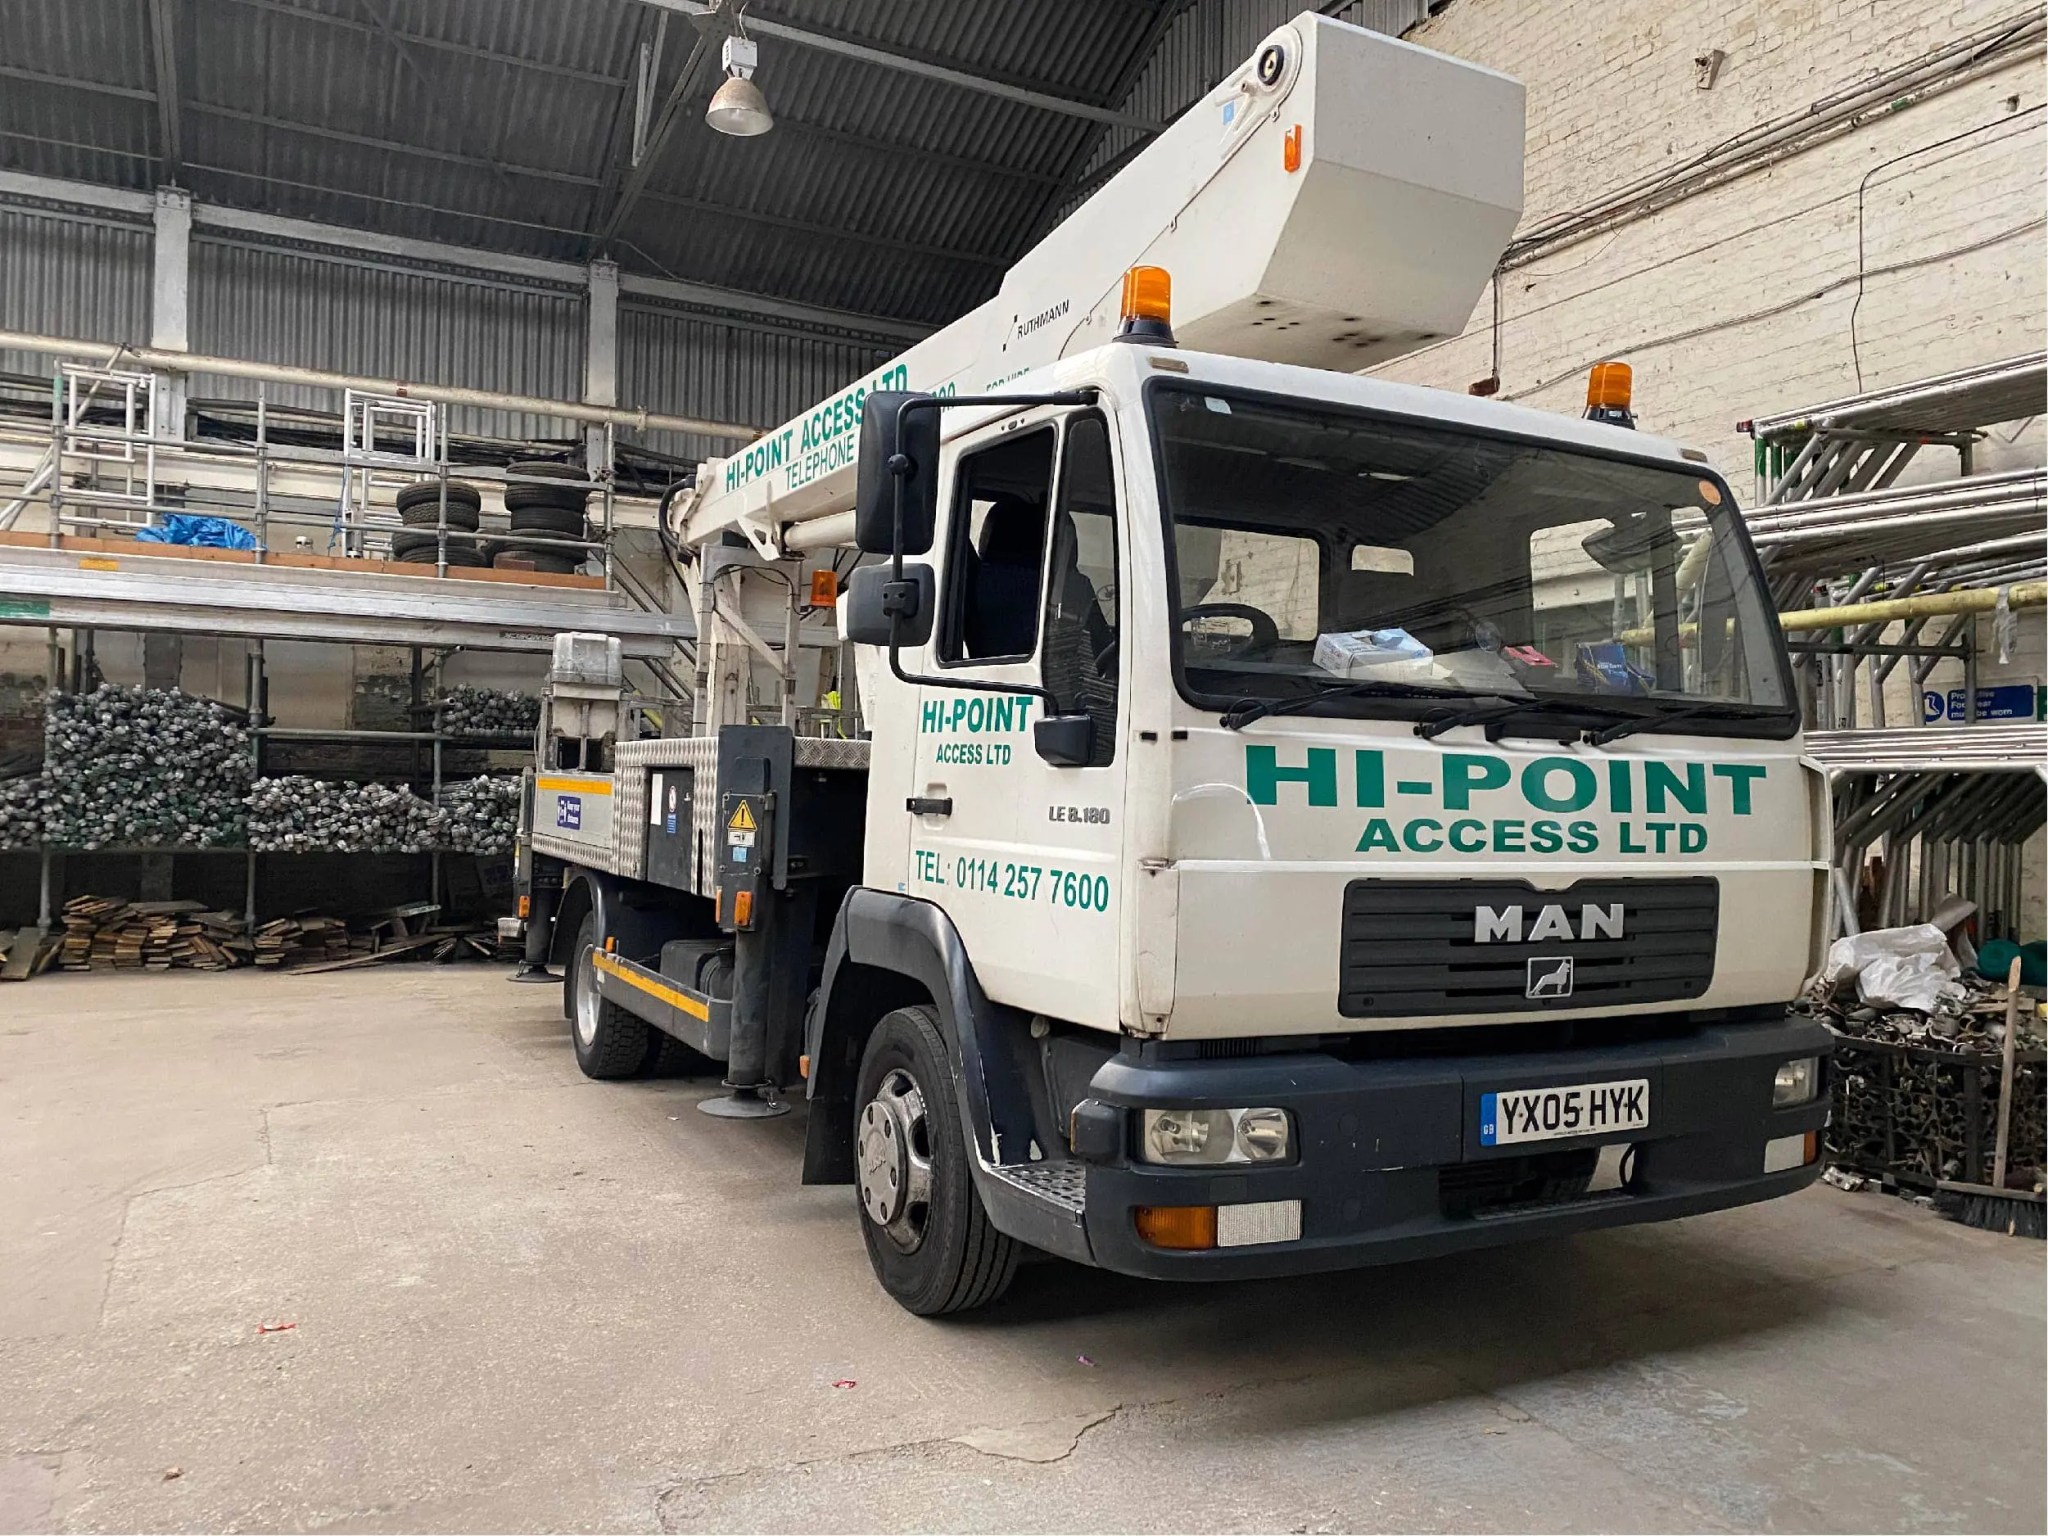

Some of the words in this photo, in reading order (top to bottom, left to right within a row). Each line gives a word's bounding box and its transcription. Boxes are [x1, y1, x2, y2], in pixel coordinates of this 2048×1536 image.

[1017, 299, 1070, 340] RUTHMANN
[726, 428, 793, 493] HI-POINT
[800, 387, 865, 454] ACCESS
[785, 434, 855, 491] TELEPHONE
[922, 696, 1034, 734] HI-POINT
[936, 744, 983, 765] ACCESS
[986, 745, 1011, 765] LTD
[1245, 744, 1768, 816] HI-POINT
[1048, 805, 1066, 822] LE
[1067, 806, 1110, 825] 8.180
[1355, 818, 1600, 854] ACCESS
[1619, 821, 1708, 854] LTD
[915, 850, 951, 886] TEL:
[957, 857, 998, 894] 0114
[1003, 863, 1043, 901] 257
[1050, 869, 1109, 914] 7600
[1473, 902, 1625, 944] MAN
[1502, 1092, 1581, 1135] YX05
[1589, 1086, 1644, 1126] HYK
